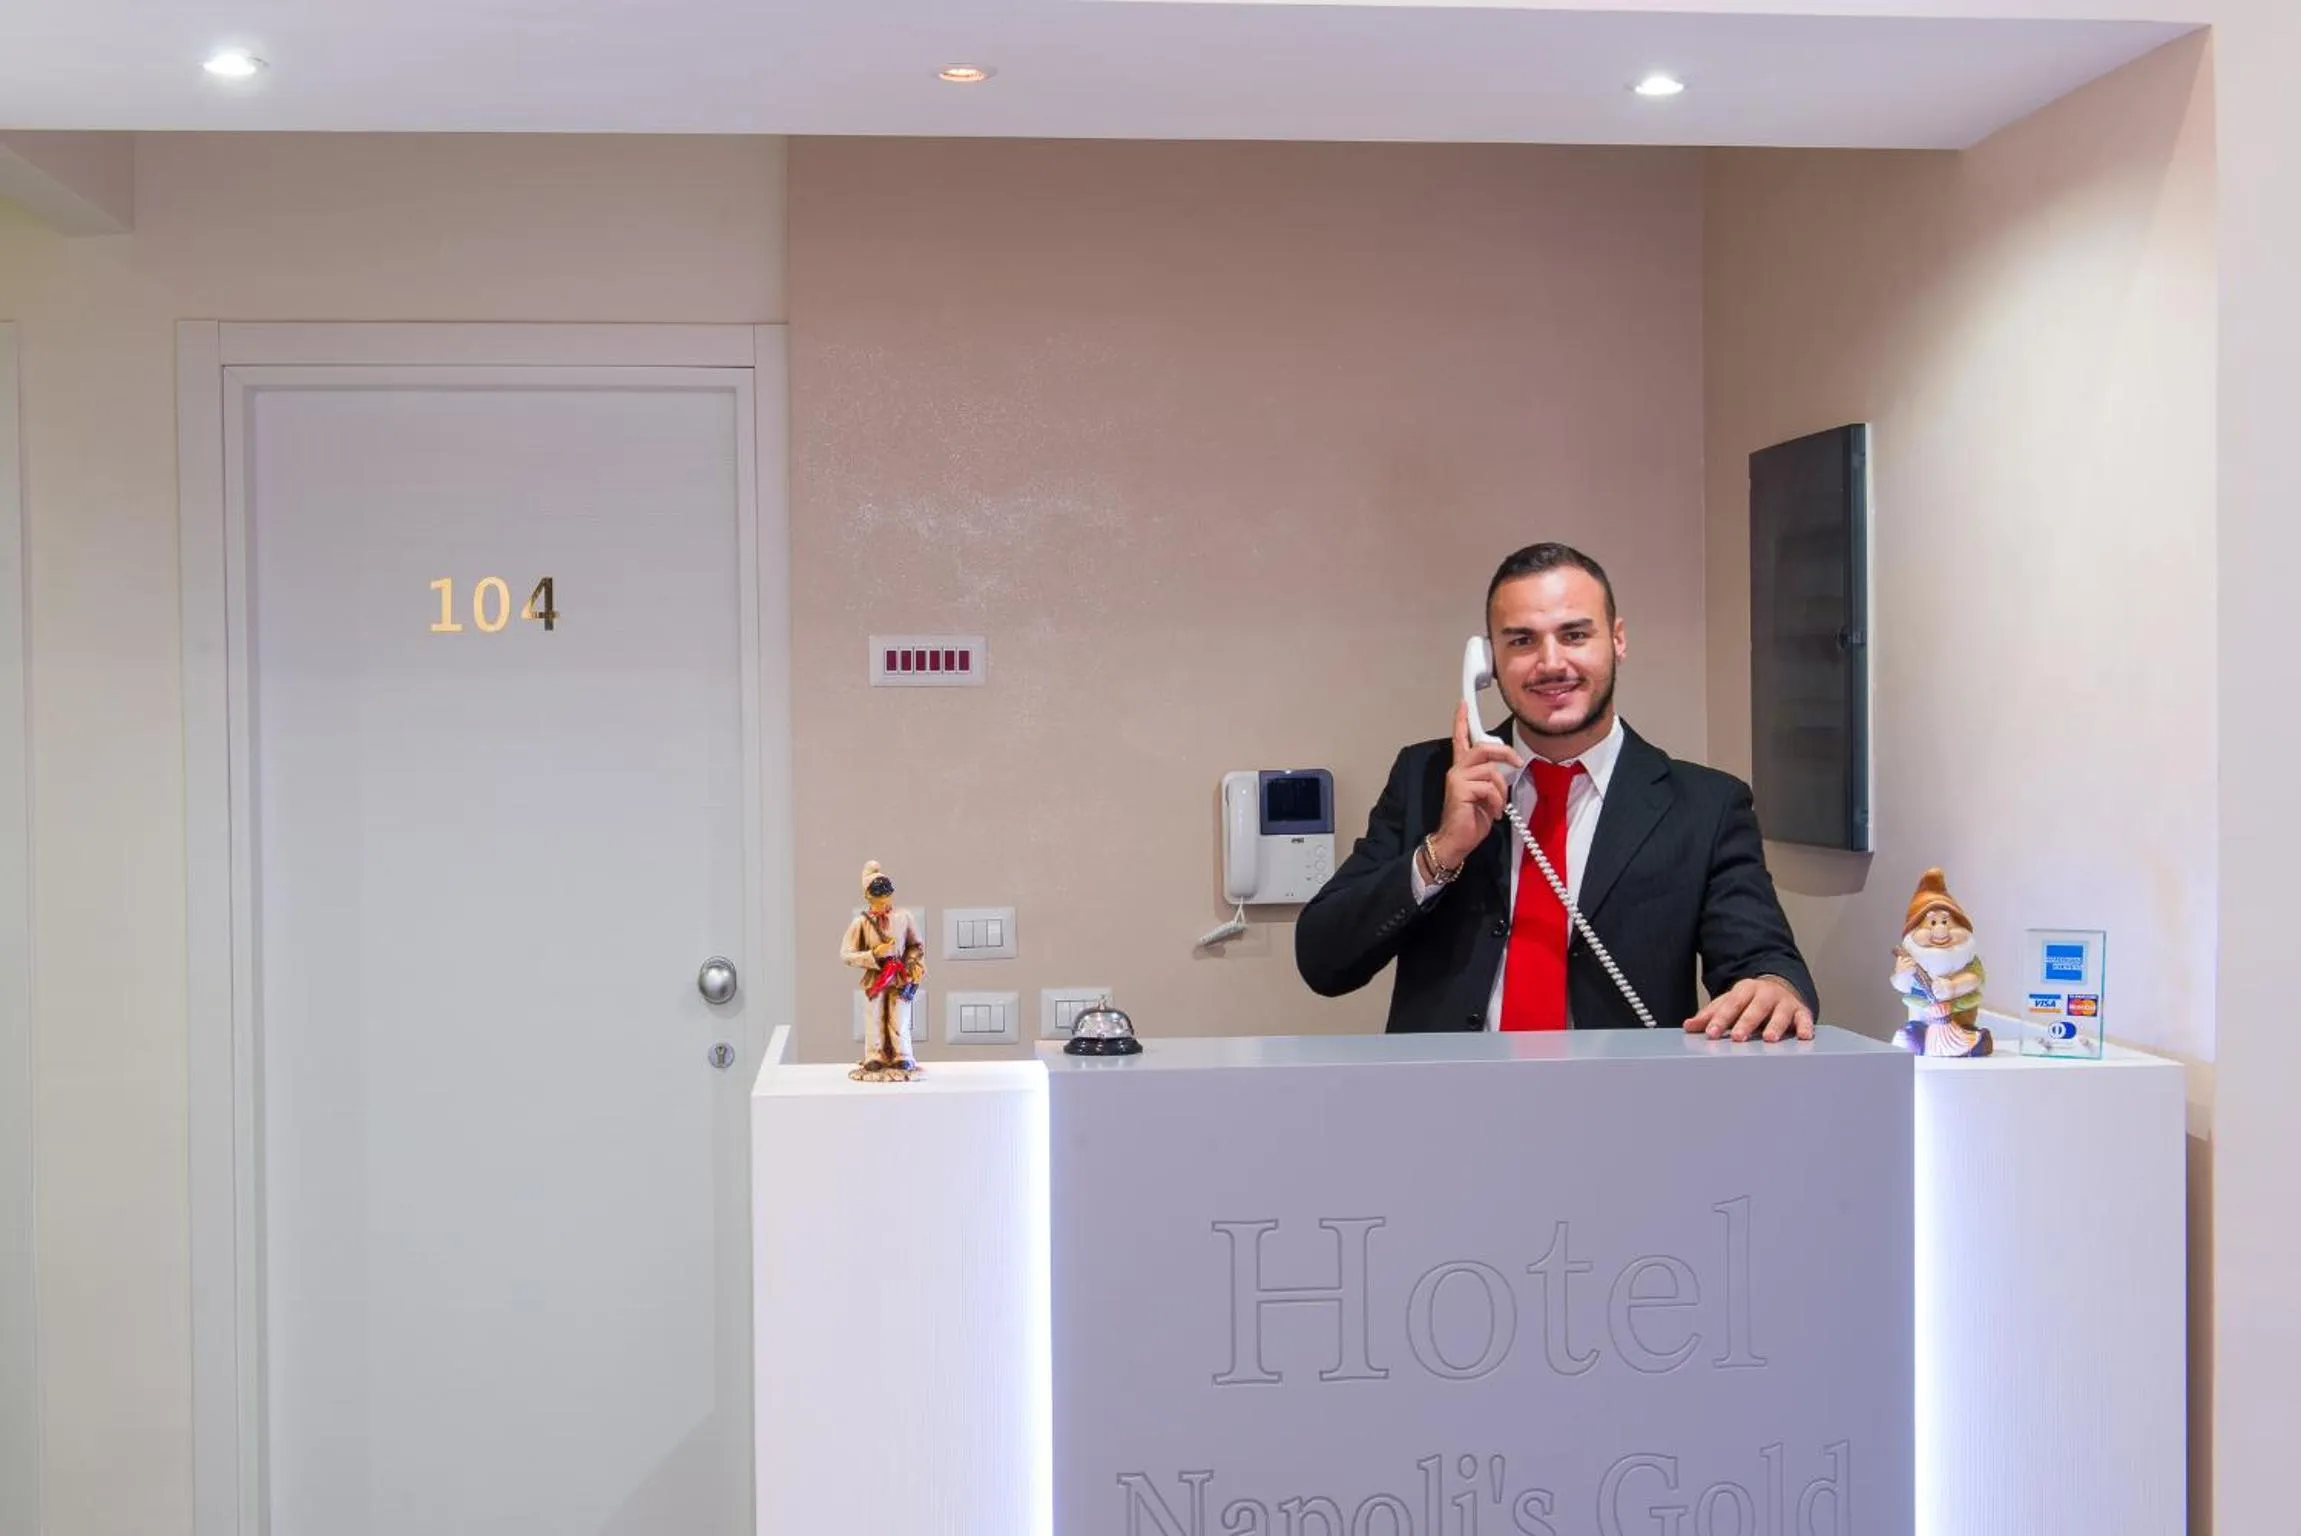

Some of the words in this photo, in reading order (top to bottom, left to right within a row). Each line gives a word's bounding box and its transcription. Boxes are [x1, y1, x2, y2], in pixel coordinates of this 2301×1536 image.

[429, 576, 560, 632] 104
[1211, 1195, 1768, 1385] Hotel
[1596, 1439, 1850, 1536] Gold
